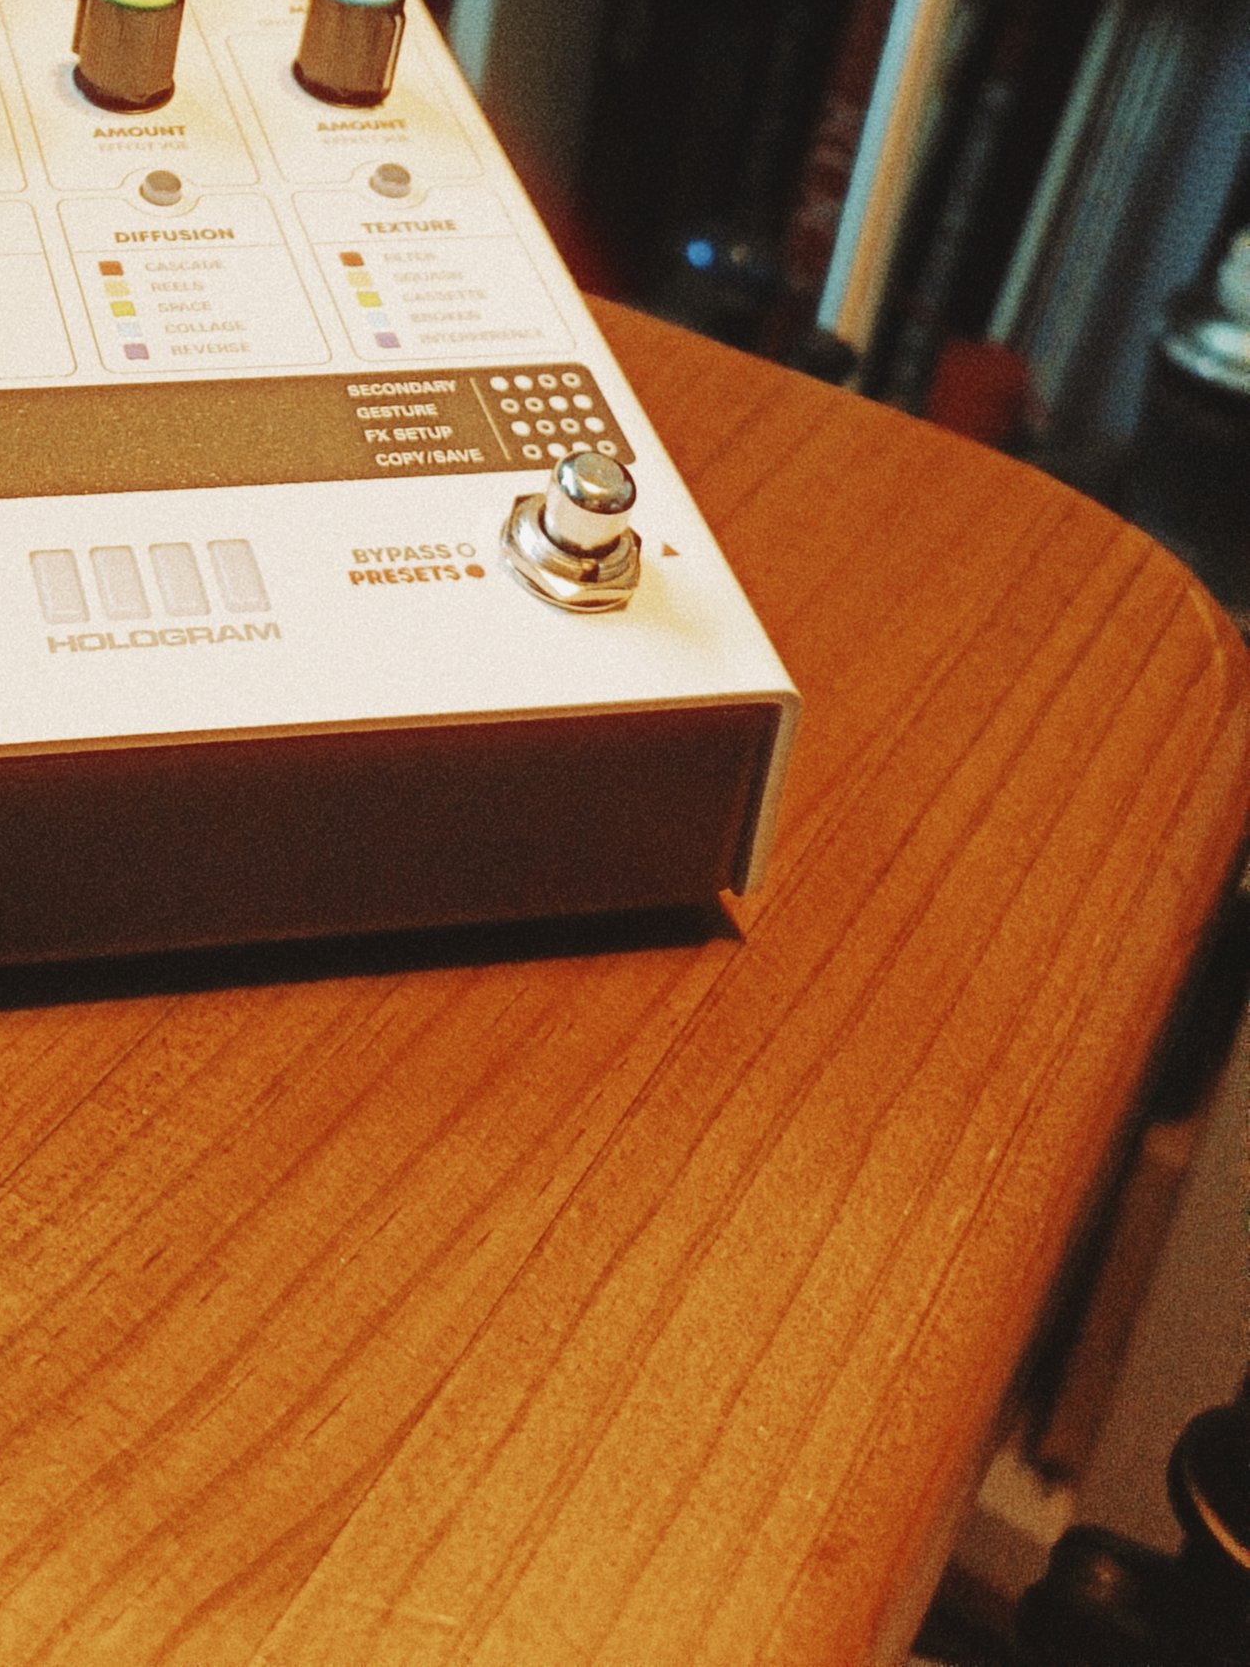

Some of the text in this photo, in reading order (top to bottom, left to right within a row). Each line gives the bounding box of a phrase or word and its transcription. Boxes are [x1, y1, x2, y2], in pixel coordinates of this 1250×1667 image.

[93, 125, 186, 138] AMOUNT
[317, 118, 406, 132] AMOUNT
[360, 220, 457, 234] TEXTURE
[114, 228, 235, 243] DIFFUSION
[145, 260, 223, 272] CASCADE
[151, 281, 204, 293] REELS
[157, 301, 212, 313] SPACE
[164, 320, 246, 334] COLLAGE
[170, 342, 251, 356] REVERSE
[347, 380, 456, 397] SECONDARY
[356, 403, 438, 419] GESTURE
[364, 425, 453, 443] FX SETUP
[375, 448, 485, 467] COPY/SAVE
[352, 544, 452, 564] BYPASS
[348, 564, 461, 586] PRESETS
[47, 622, 281, 653] HOLOGRAM
